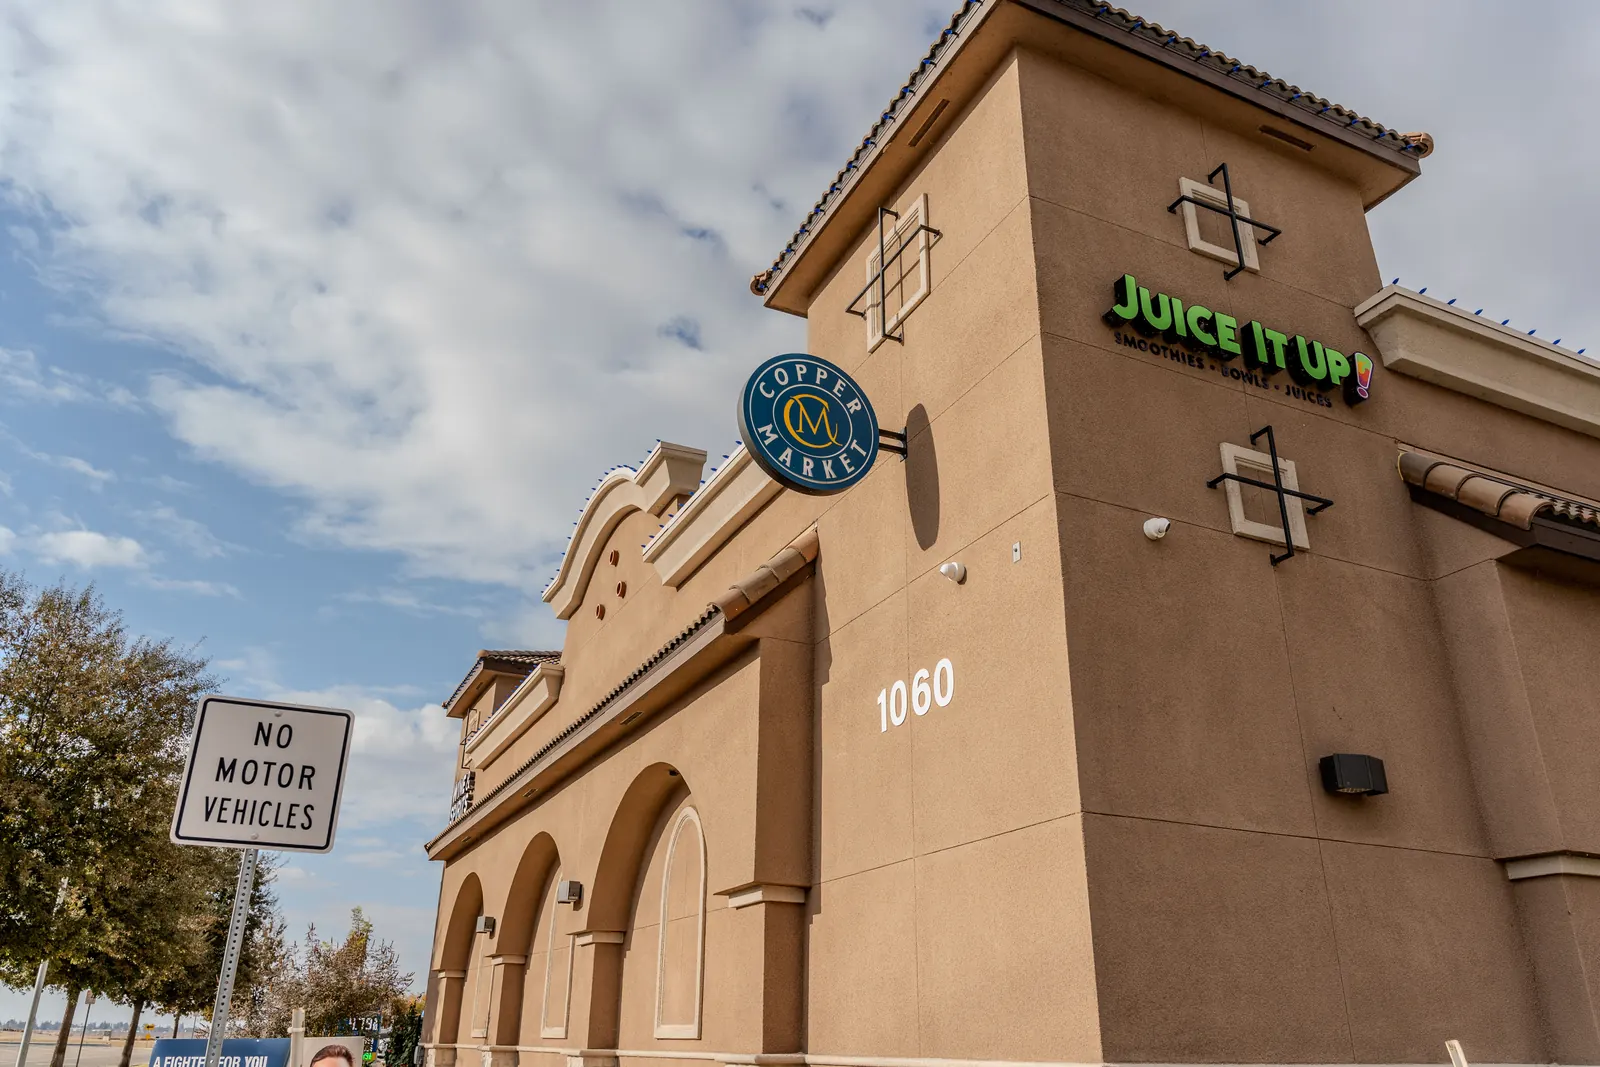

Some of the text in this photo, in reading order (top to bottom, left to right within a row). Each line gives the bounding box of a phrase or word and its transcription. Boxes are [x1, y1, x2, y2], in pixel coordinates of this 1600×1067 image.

[1111, 273, 1241, 356] JUICE
[1251, 320, 1288, 369] IT
[758, 363, 862, 415] COPPER
[1113, 331, 1333, 409] SMOOTHIES BOWLS JUICES
[757, 423, 867, 479] MARKET
[877, 657, 955, 733] 1060
[253, 721, 293, 749] NO
[214, 756, 316, 790] MOTOR
[203, 795, 315, 831] VEHICLES
[152, 1056, 268, 1067] A FIGHTE FOR YOU
